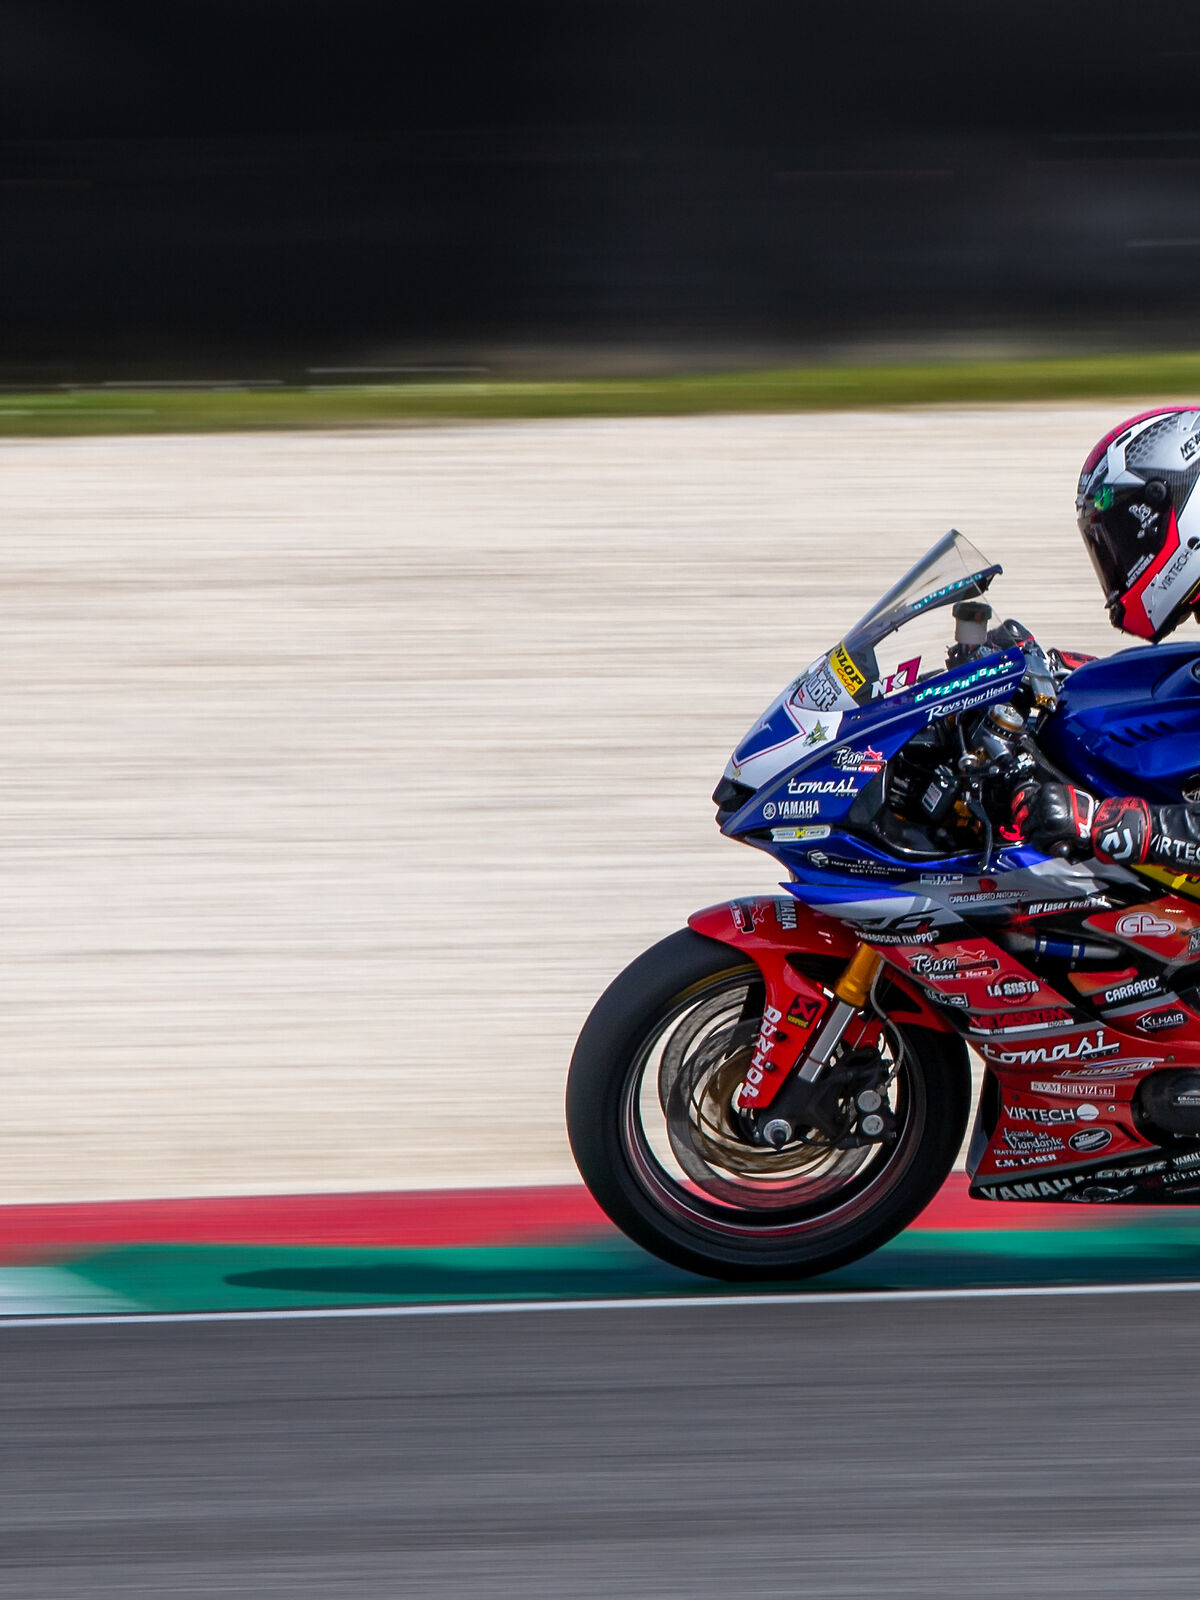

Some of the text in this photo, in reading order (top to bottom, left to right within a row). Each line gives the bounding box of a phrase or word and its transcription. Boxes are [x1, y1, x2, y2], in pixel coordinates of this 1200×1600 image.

[788, 776, 859, 794] tomasi
[778, 800, 820, 815] YAMAHA
[781, 898, 797, 930] MAHA
[910, 954, 959, 973] Team
[1105, 976, 1158, 1003] CARRARO
[742, 1004, 782, 1098] DUNLOP
[980, 1029, 1120, 1065] tomasi
[1003, 1104, 1076, 1122] VIRTECH
